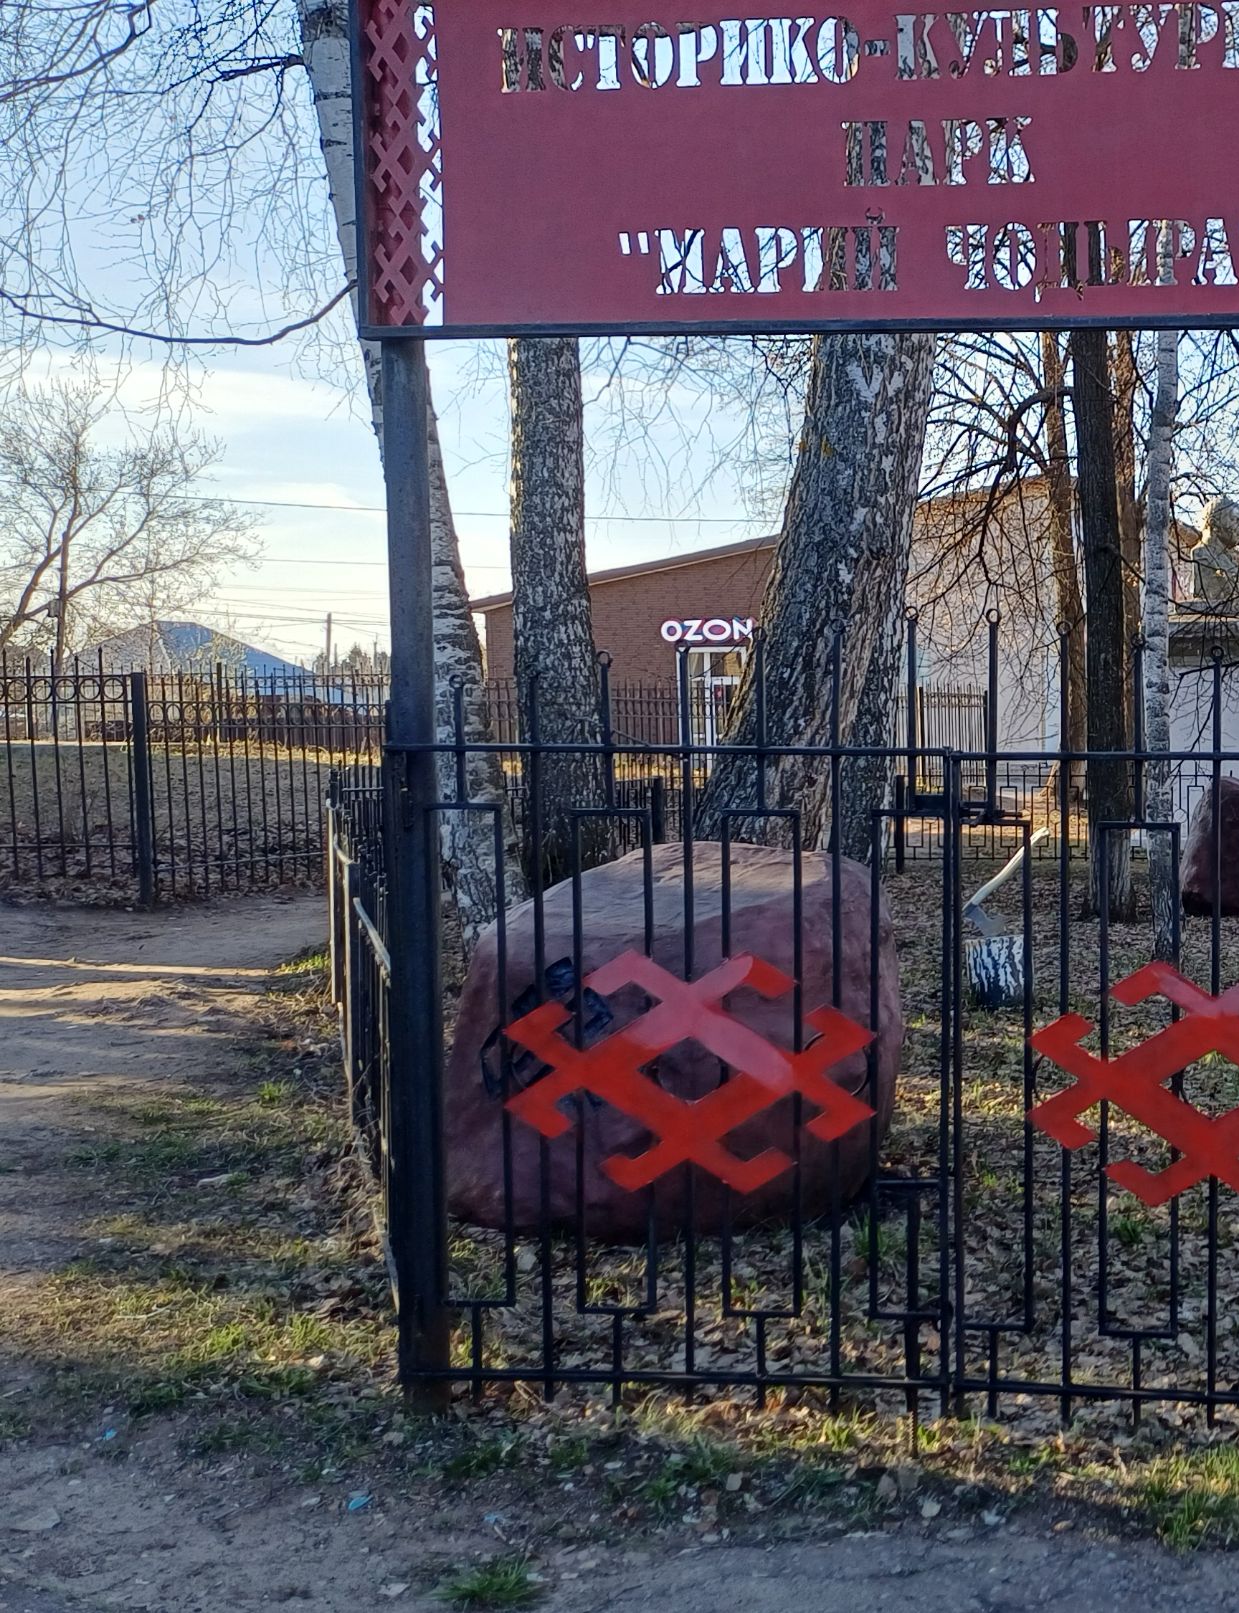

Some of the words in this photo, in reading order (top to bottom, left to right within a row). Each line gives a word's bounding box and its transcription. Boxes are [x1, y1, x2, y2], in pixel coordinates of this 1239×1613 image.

[841, 116, 1035, 187] ПАРК
[618, 207, 900, 294] "МАРИЙ
[661, 618, 754, 641] OZON
